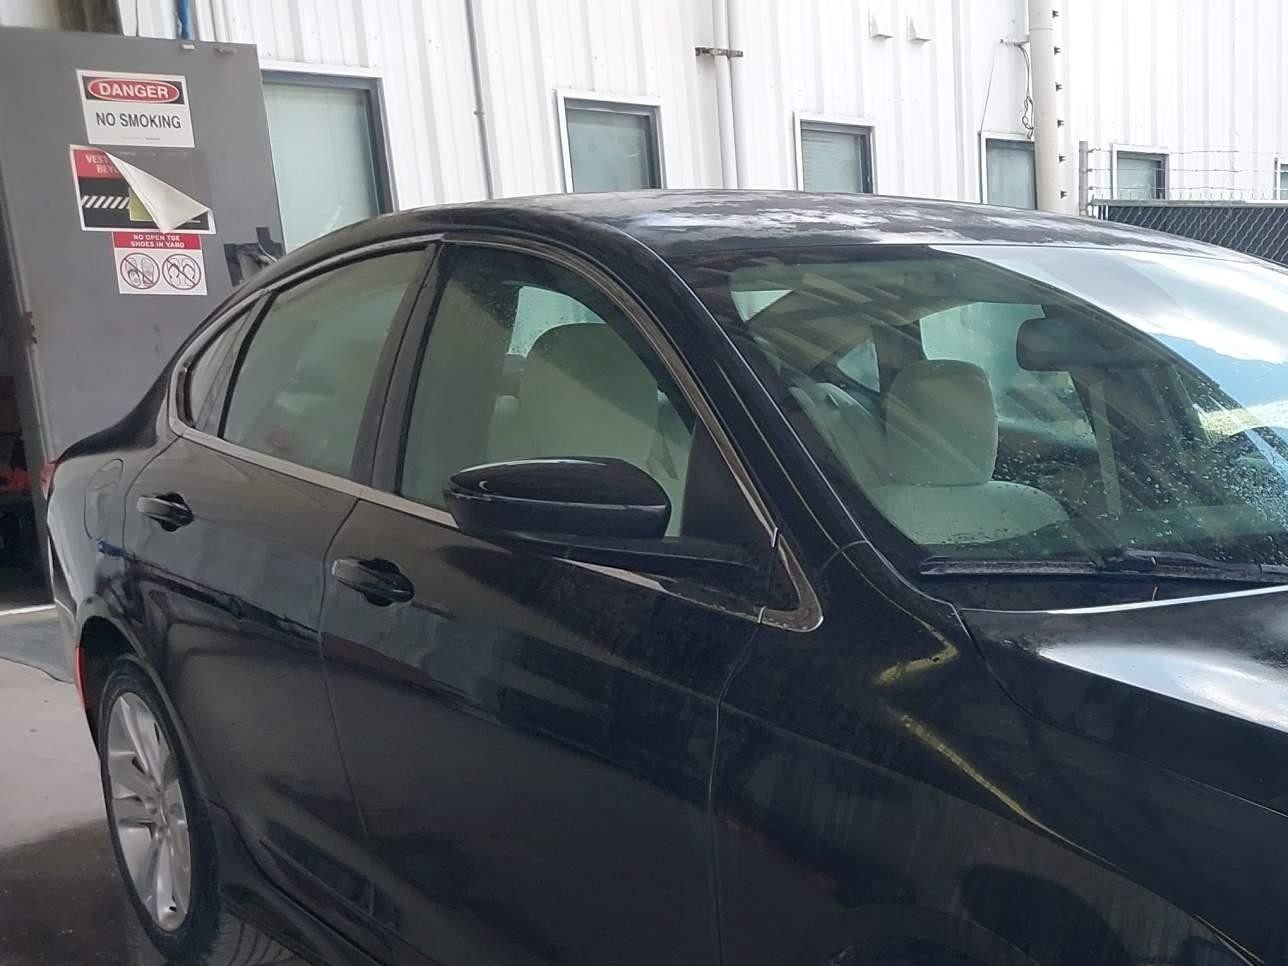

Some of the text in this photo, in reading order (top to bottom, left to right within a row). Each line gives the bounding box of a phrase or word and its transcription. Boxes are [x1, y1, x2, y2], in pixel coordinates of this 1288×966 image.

[98, 82, 169, 99] DANGER
[96, 112, 182, 129] NO SMOKING
[145, 234, 165, 242] OPEN
[156, 241, 164, 249] IN
[165, 241, 185, 249] YARD
